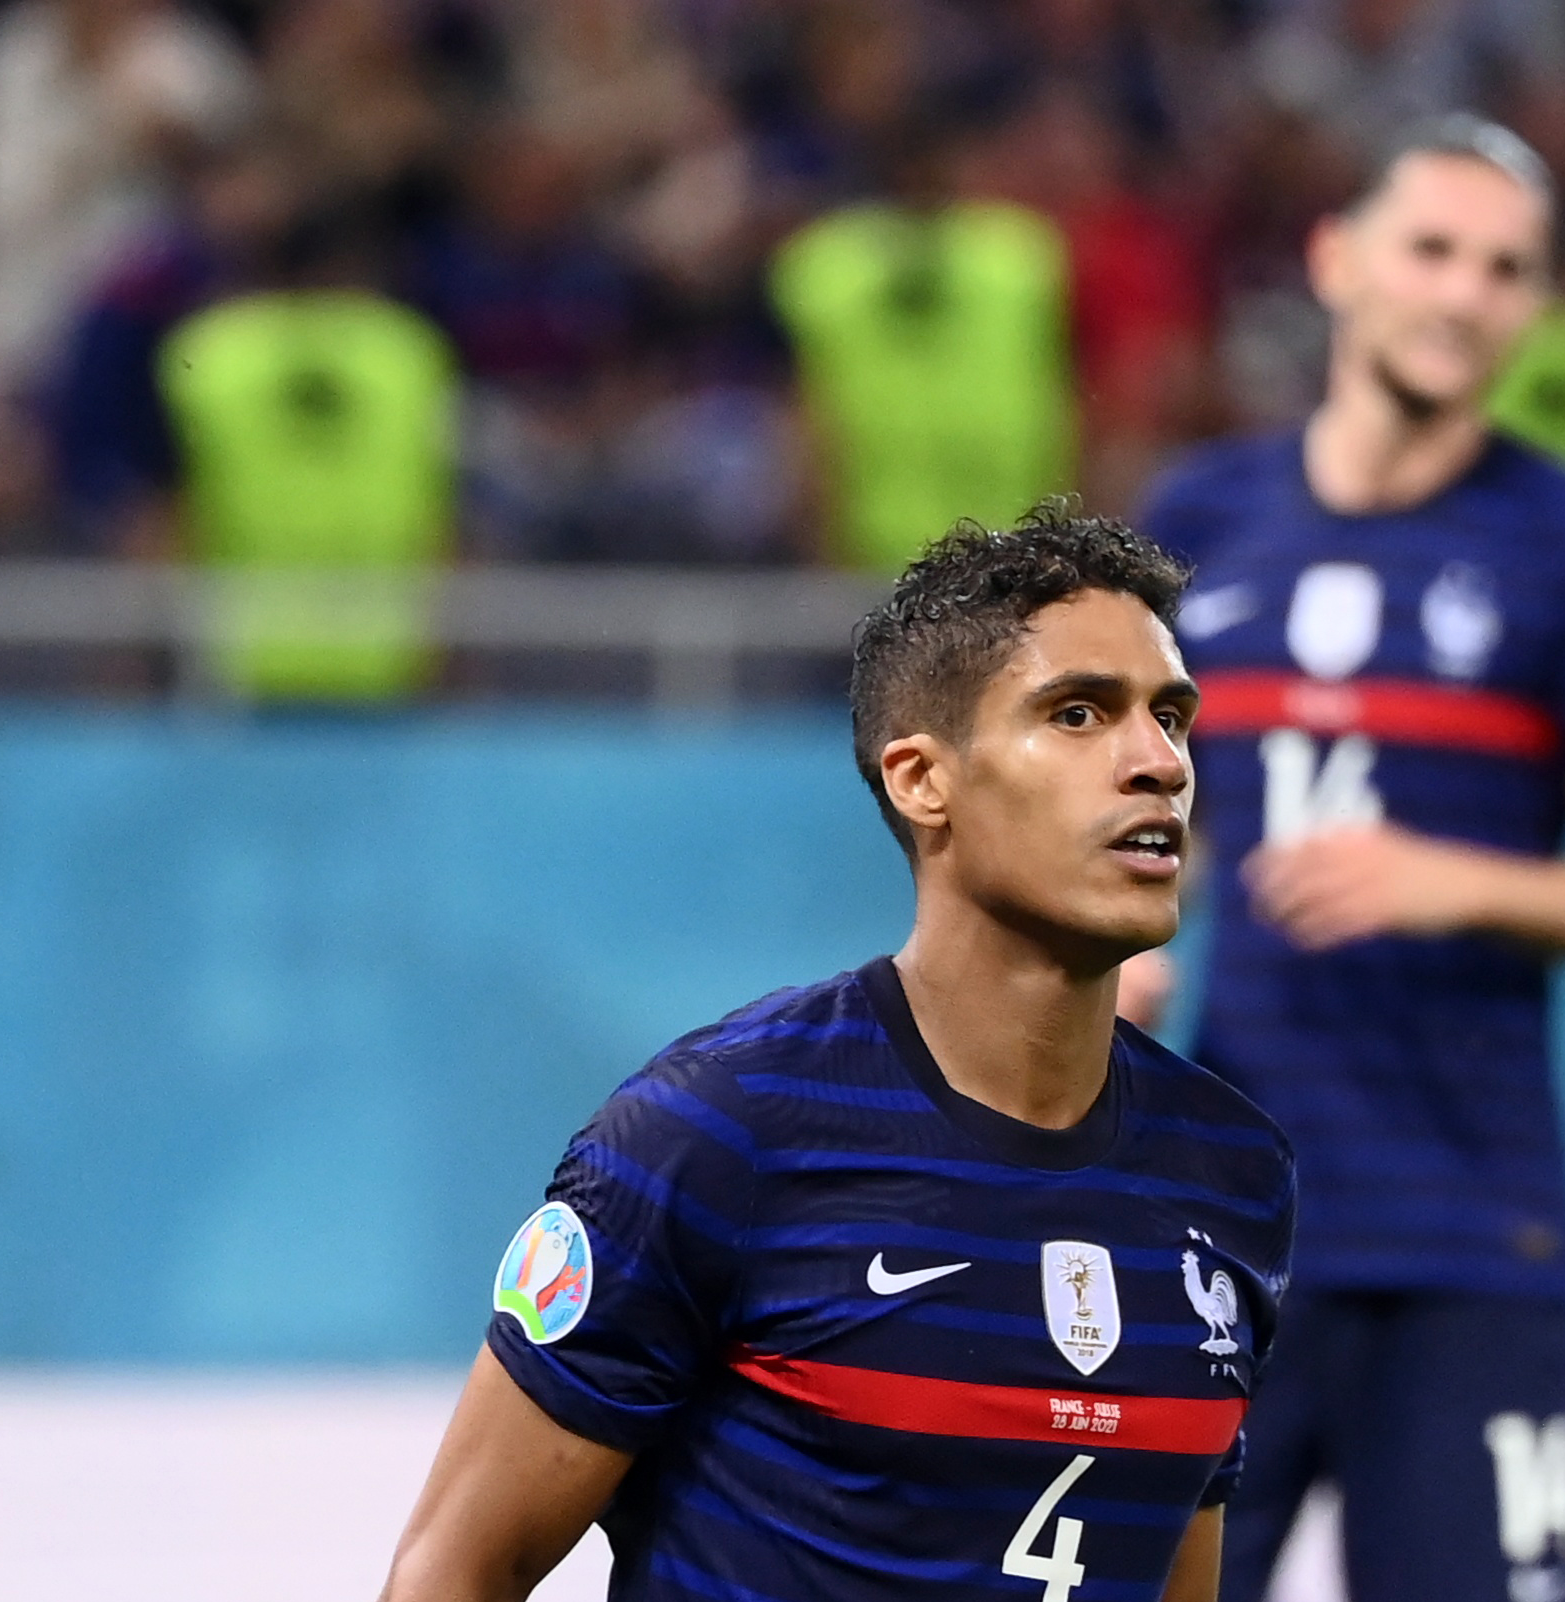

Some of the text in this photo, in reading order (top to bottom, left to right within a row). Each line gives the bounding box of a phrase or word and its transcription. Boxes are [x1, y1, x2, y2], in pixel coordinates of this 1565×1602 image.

[1070, 1325, 1100, 1340] FIFA
[1049, 1397, 1085, 1415] FRANCE
[1089, 1417, 1118, 1434] 2021
